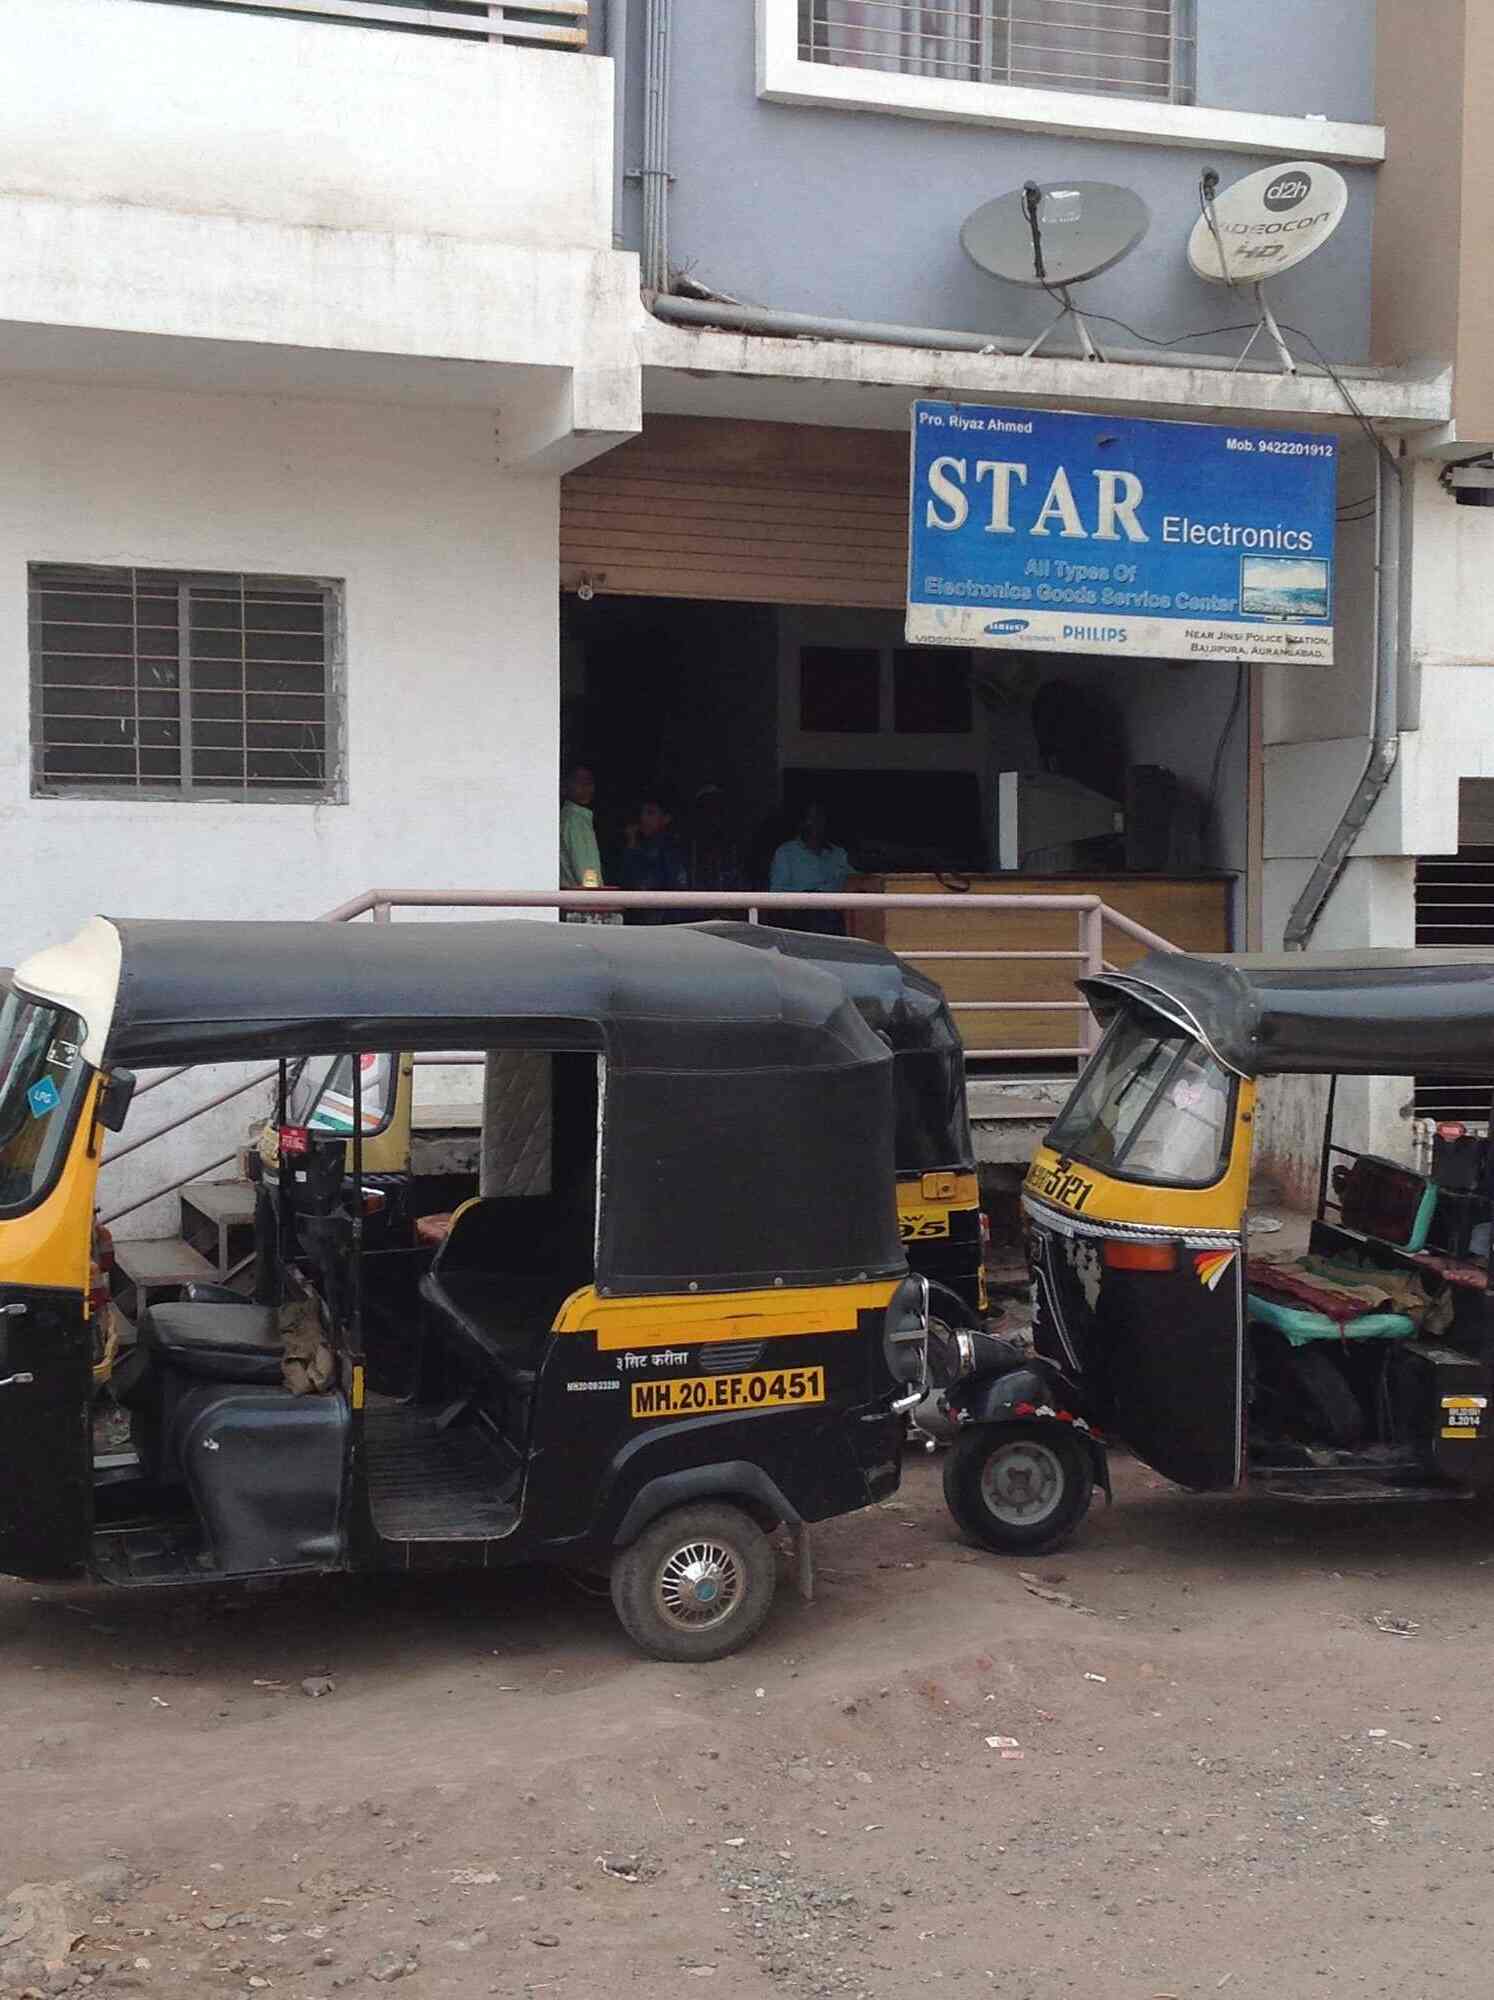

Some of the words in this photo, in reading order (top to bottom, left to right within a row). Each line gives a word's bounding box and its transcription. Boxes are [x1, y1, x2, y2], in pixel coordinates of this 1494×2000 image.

[1266, 180, 1307, 200] d2h
[919, 412, 945, 427] Pro.
[949, 414, 985, 432] Riyaz
[987, 417, 1033, 434] Ahmed
[1226, 437, 1256, 451] Mob.
[1258, 440, 1334, 457] 9422201912
[926, 456, 1150, 543] STAR
[1162, 516, 1313, 551] Electronics
[1024, 559, 1050, 578] All
[1054, 560, 1110, 582] Types
[1113, 564, 1137, 582] Of
[925, 576, 1032, 600] Electronics
[1036, 583, 1097, 605] Goods
[1101, 587, 1171, 608] Service
[1175, 592, 1240, 612] Center
[1063, 624, 1128, 643] PHILIPS
[1184, 629, 1214, 639] NEAR
[1246, 632, 1283, 643] POLICE
[635, 1371, 820, 1413] MH.20.EF.0451
